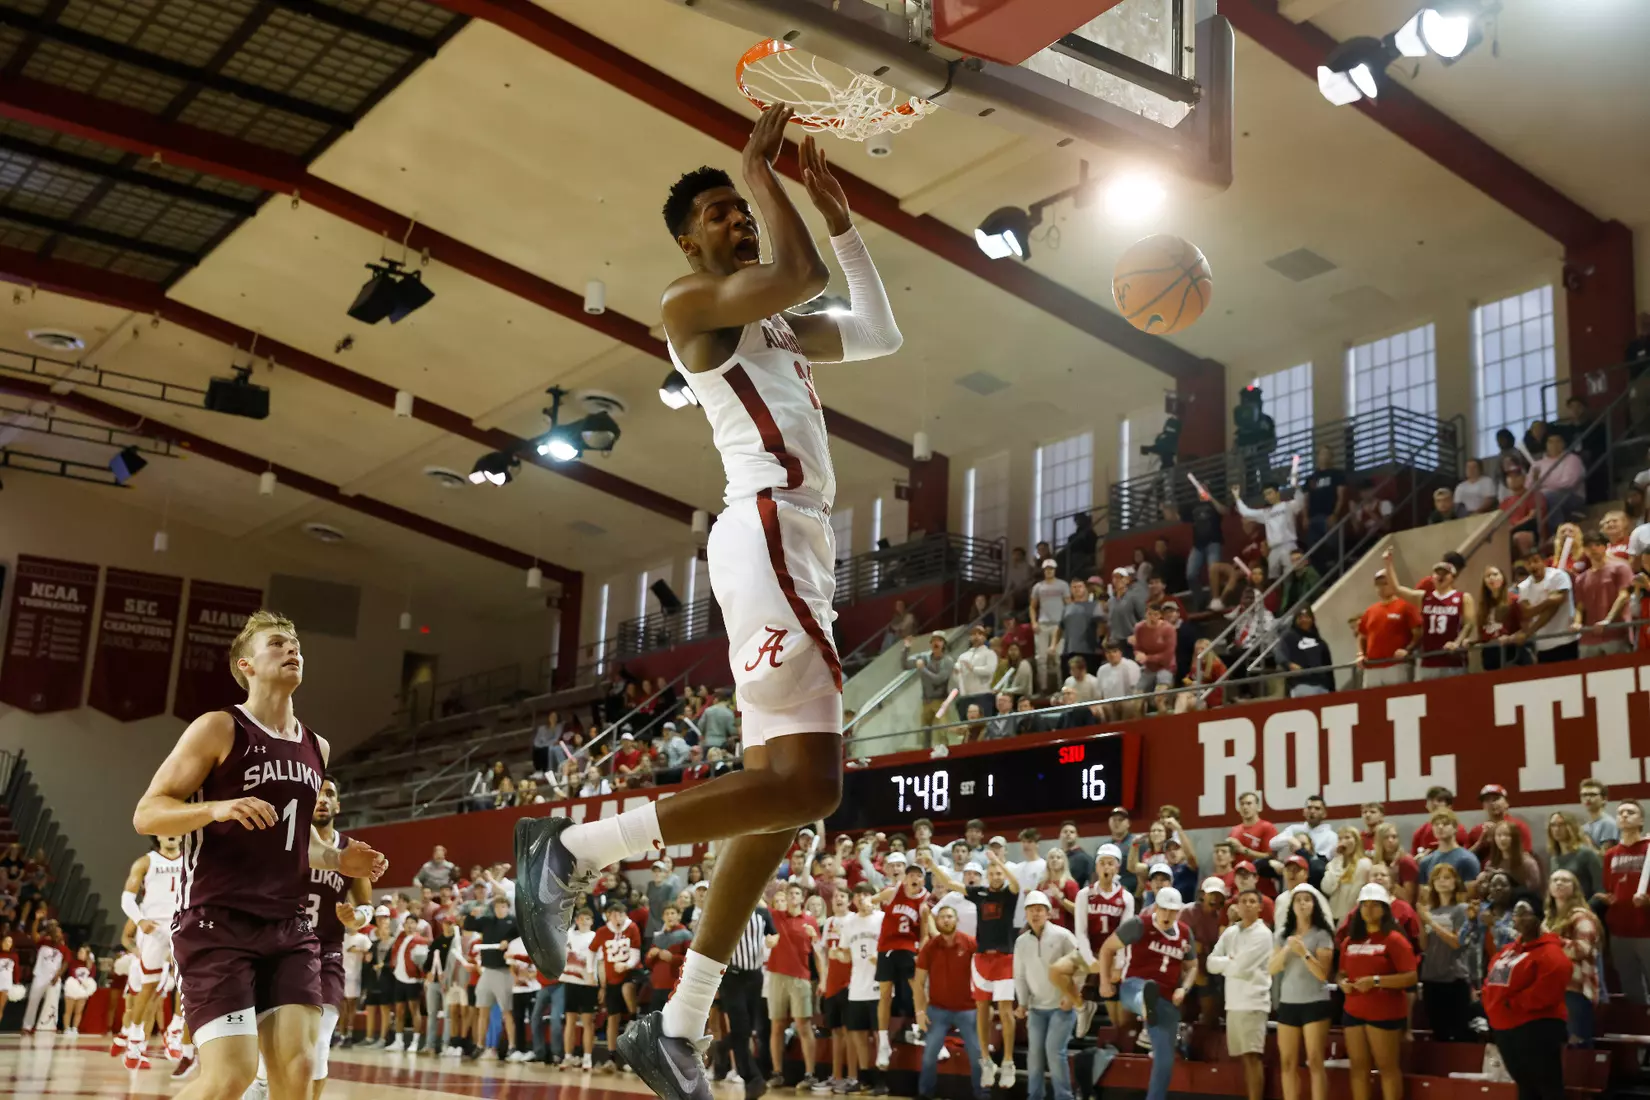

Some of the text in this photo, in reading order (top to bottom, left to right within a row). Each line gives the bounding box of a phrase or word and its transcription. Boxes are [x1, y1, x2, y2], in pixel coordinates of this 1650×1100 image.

[30, 581, 79, 602] NCAA
[124, 598, 159, 616] SEC
[1428, 615, 1448, 634] 13
[745, 625, 788, 672] A
[1198, 665, 1650, 817] ROLL TI
[1059, 744, 1085, 764] SIU
[891, 770, 949, 812] 7:48
[988, 774, 994, 797] 1
[1082, 764, 1106, 801] 16
[283, 798, 298, 851] 1
[898, 915, 910, 933] 2
[1100, 915, 1109, 934] 1
